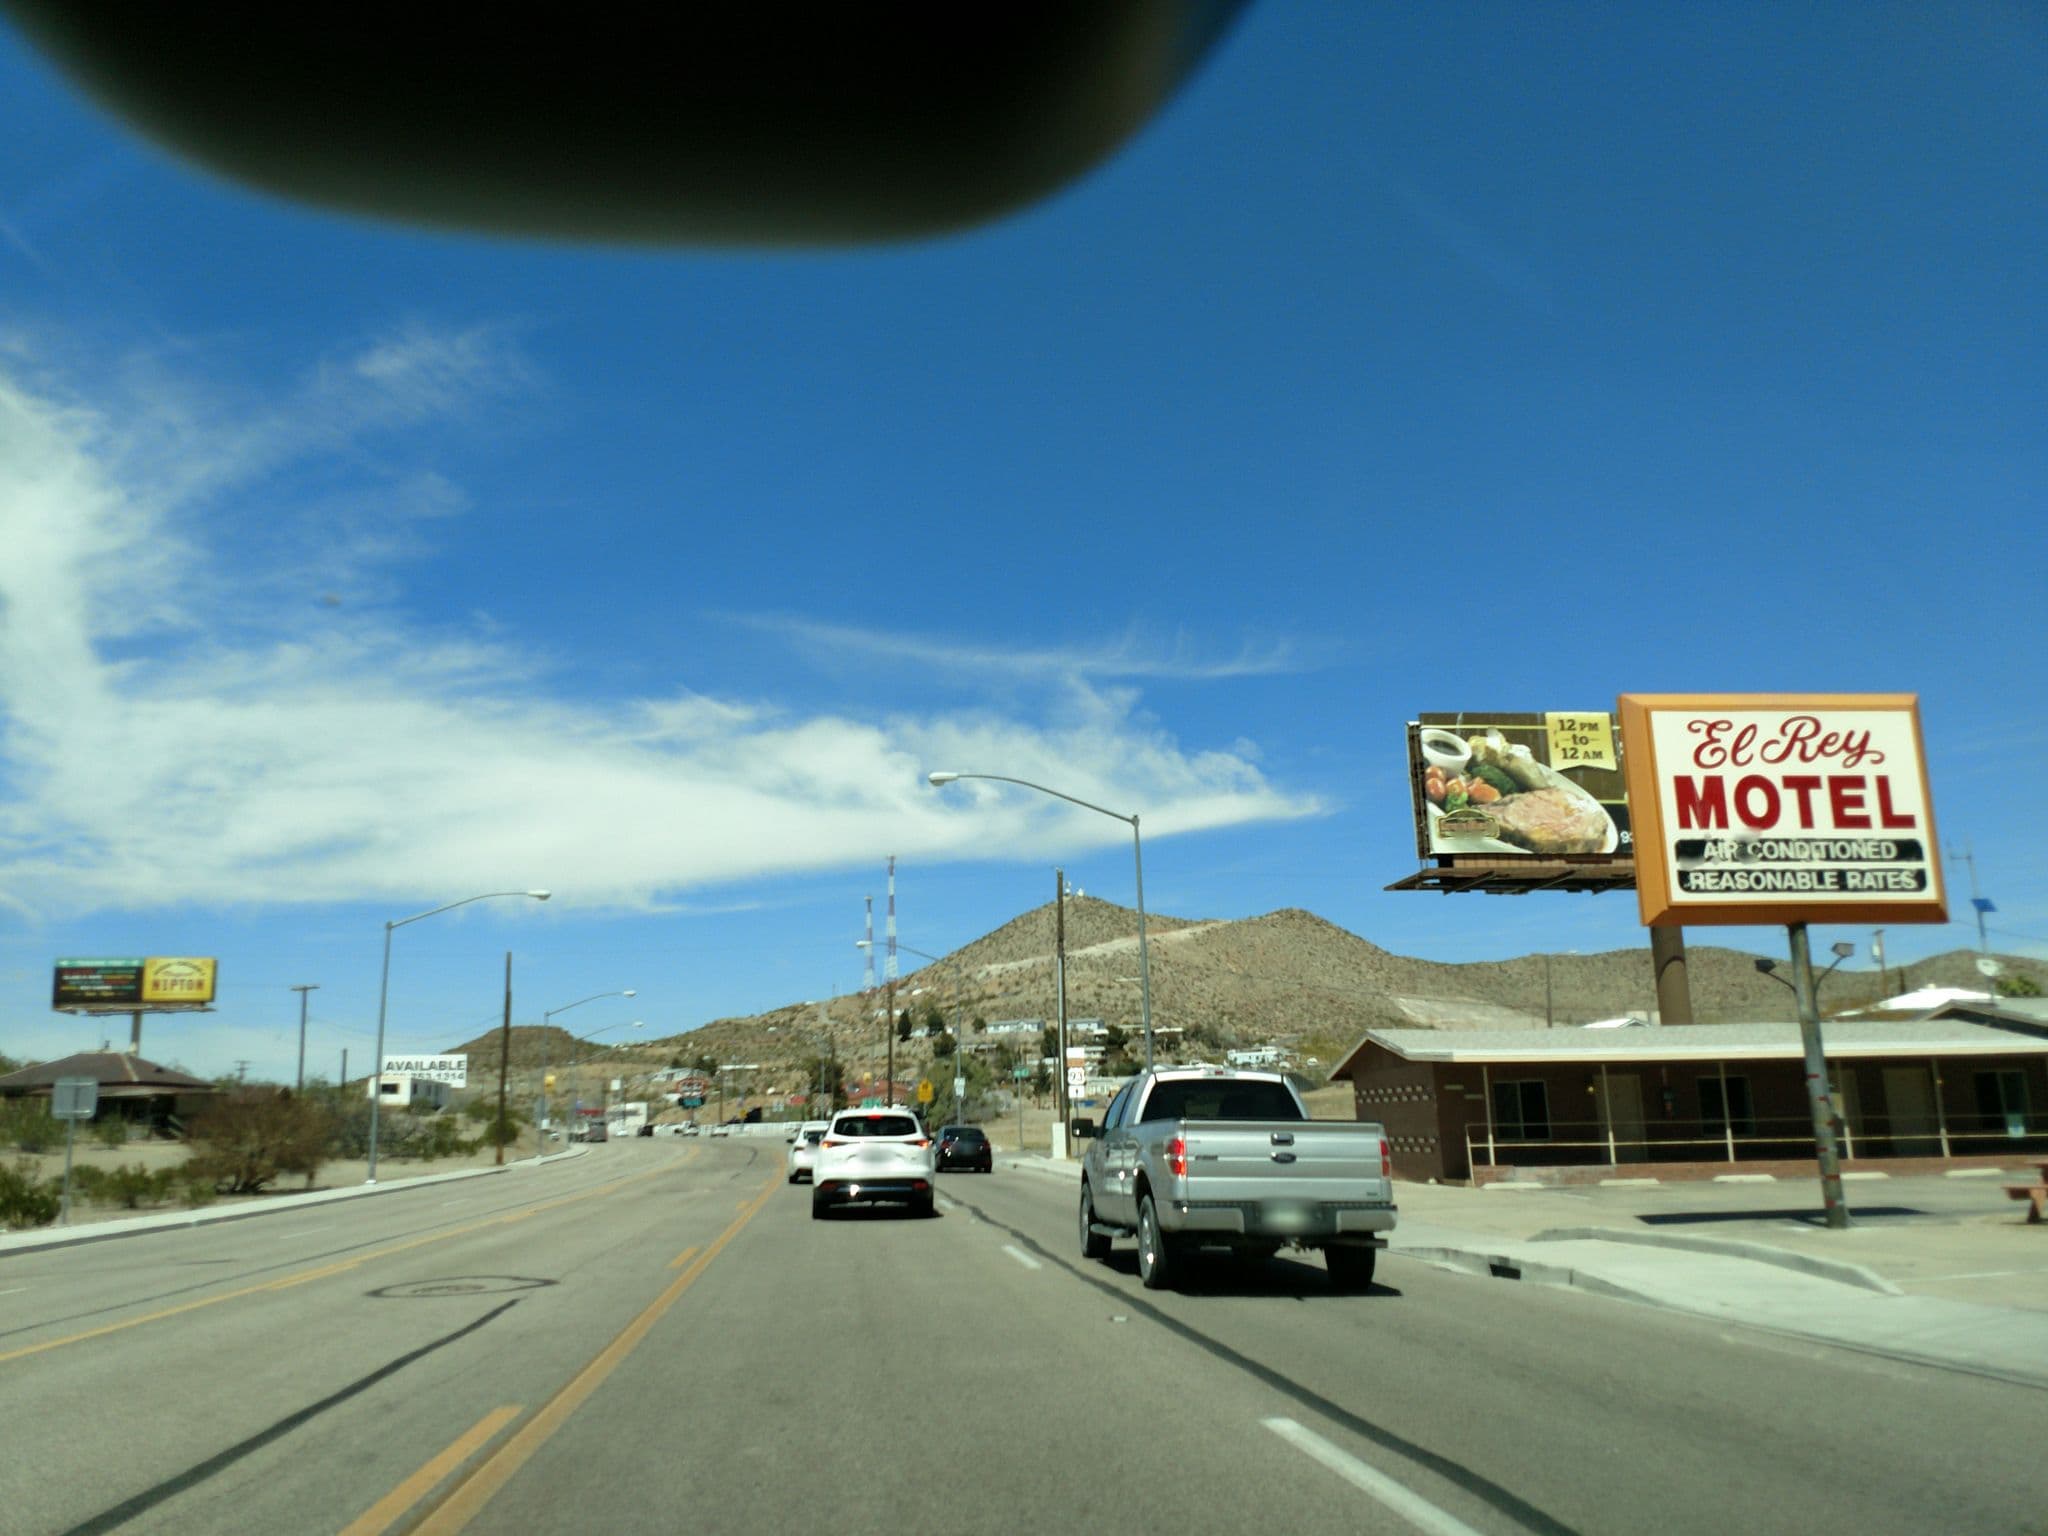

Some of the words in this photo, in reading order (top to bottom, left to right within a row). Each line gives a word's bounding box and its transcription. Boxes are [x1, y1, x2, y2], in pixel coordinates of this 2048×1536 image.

[1558, 719, 1576, 731] 12
[1579, 722, 1599, 731] PM
[1572, 734, 1589, 746] to
[1687, 720, 1757, 769] El
[1760, 716, 1885, 769] Rey
[1562, 747, 1579, 760] 12
[1583, 750, 1603, 760] AM
[1673, 775, 1916, 831] MOTEL
[1703, 842, 1739, 860] AIR
[1748, 841, 1897, 860] CONDITIONED
[1689, 872, 1840, 891] REASONABLE
[1847, 871, 1918, 890] RATES
[385, 1061, 466, 1072] AVAILABLE
